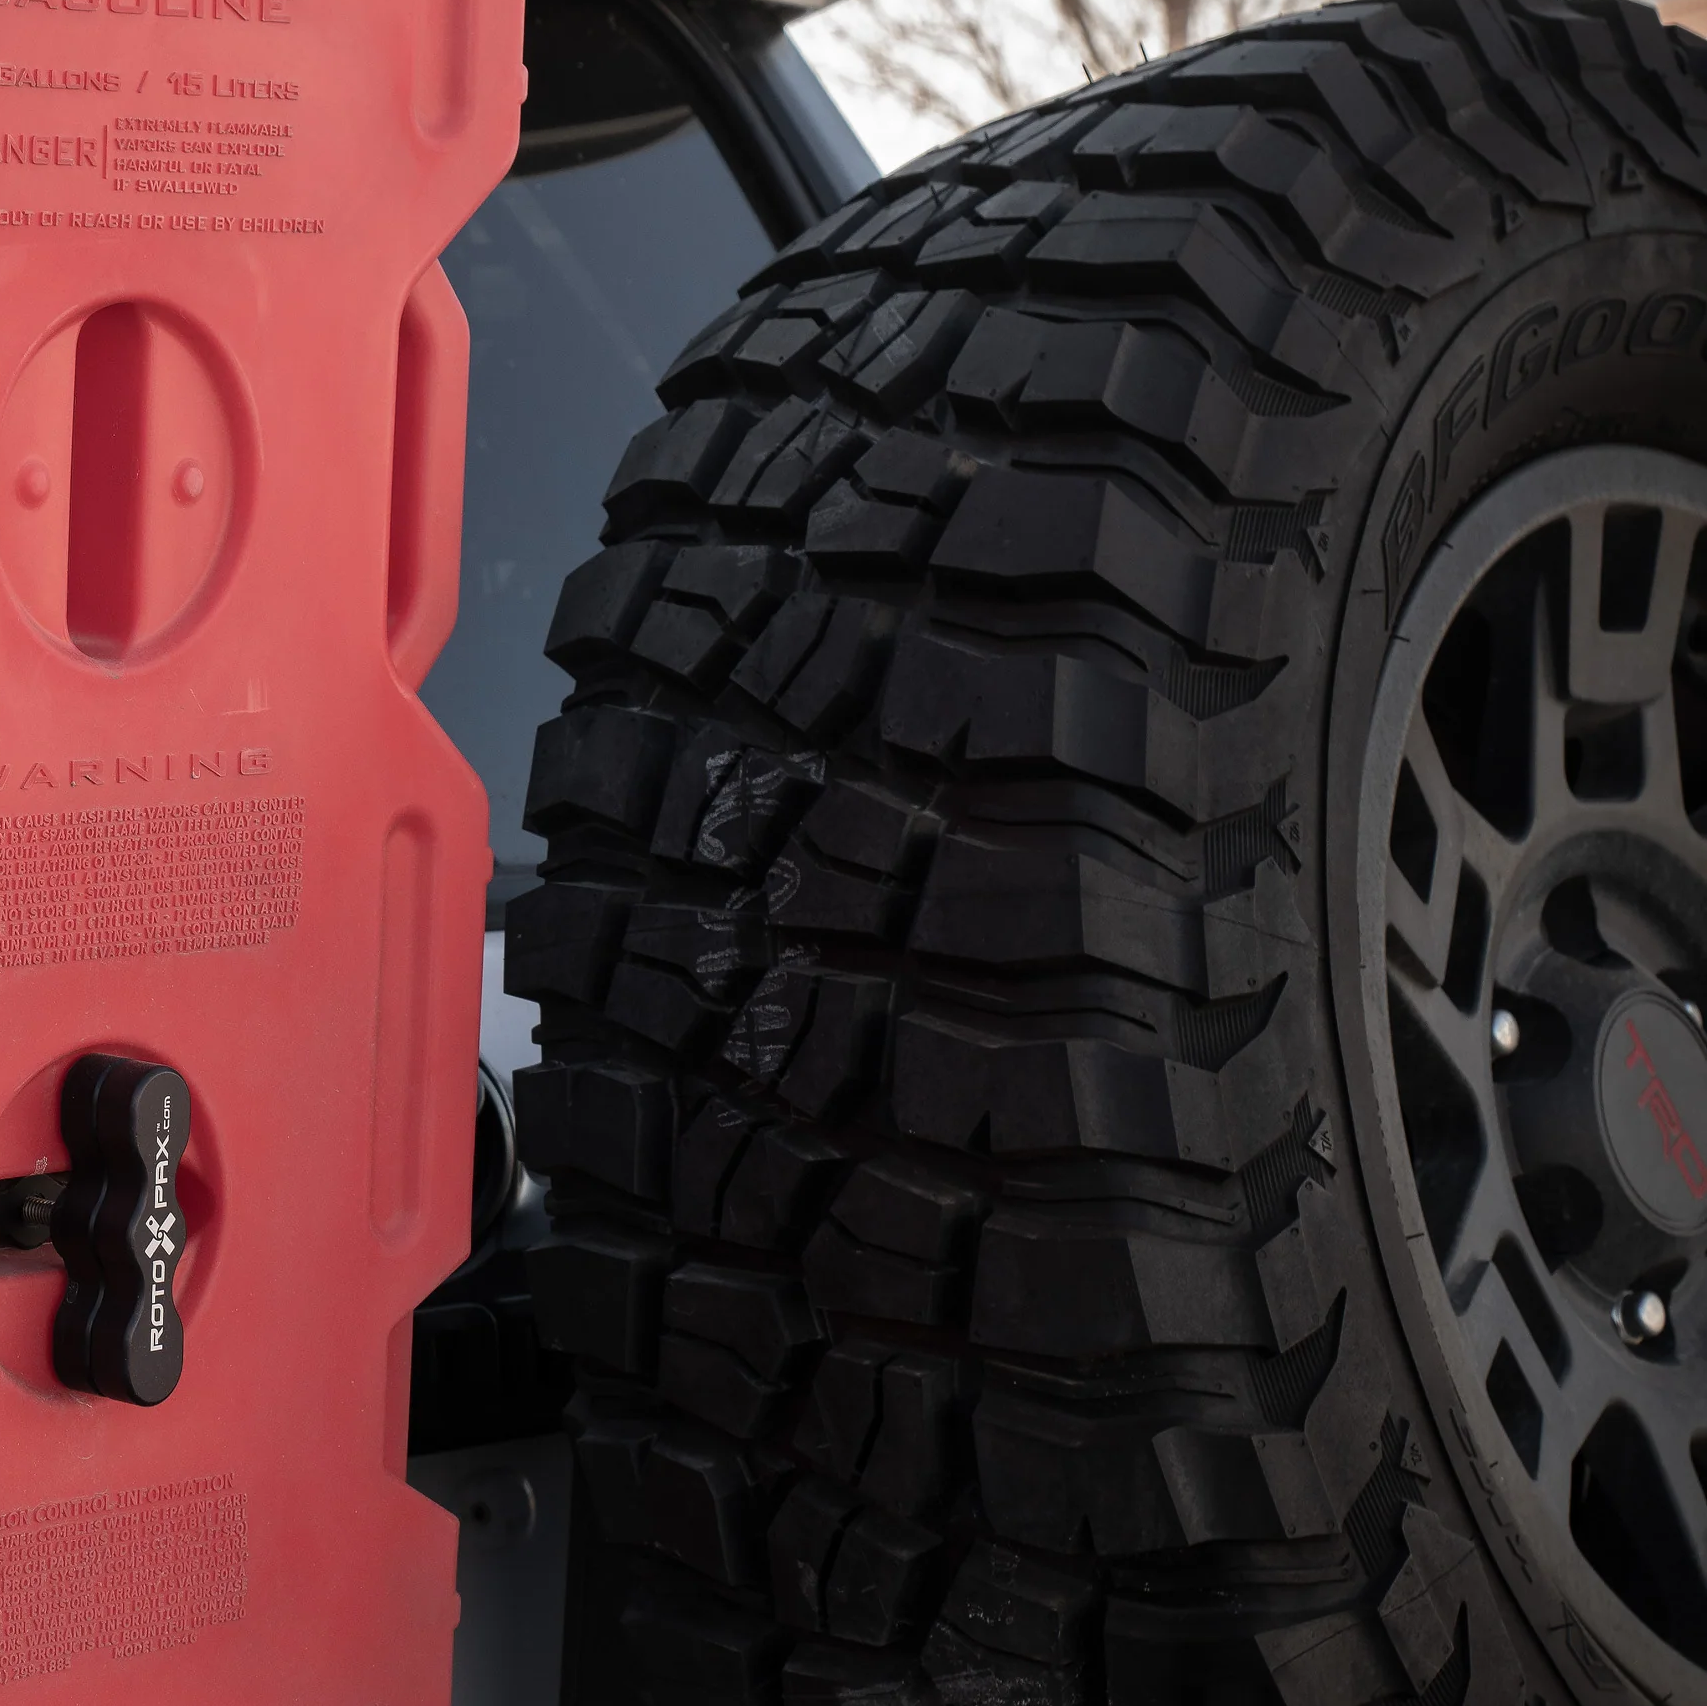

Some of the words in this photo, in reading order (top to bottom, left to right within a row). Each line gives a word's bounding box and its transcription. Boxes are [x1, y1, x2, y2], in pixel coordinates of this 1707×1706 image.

[166, 71, 204, 96] 15
[212, 74, 300, 100] LITERS
[114, 117, 203, 135] EXTREMELY
[207, 120, 294, 138] FLAMMABLE
[114, 137, 177, 154] VAPORS
[181, 140, 214, 155] CAN
[217, 141, 286, 157] EXPLODE
[114, 158, 186, 174] HARMFUL
[190, 160, 214, 175] OR
[217, 160, 262, 176] FATAL
[113, 178, 130, 191] IF
[135, 178, 239, 196] SWALLOWED
[40, 210, 64, 227] OF
[70, 211, 133, 230] REACH
[138, 214, 164, 231] OR
[171, 215, 207, 231] USE
[212, 216, 236, 232] BY
[240, 217, 326, 234] CHILDREN
[15, 812, 59, 828] CAUSE
[63, 809, 105, 825] FLASH
[147, 803, 199, 820] VAPORS
[201, 802, 229, 816] CAN
[253, 797, 305, 813] IGNITED
[7, 830, 26, 844] BY
[41, 826, 81, 842] SPARK
[85, 825, 103, 839] OR
[149, 819, 181, 835] MANY
[217, 815, 251, 830] AWAY
[263, 813, 279, 827] DO
[50, 840, 91, 857] AVOID
[157, 835, 173, 849] OR
[177, 829, 251, 848] PROLONGED
[253, 826, 305, 842] CONTACT
[16, 856, 91, 875] BREATHING
[180, 844, 258, 863] SWALLOWED
[261, 843, 279, 857] DO
[11, 920, 58, 936] REACH
[222, 899, 301, 919] CONTAINER
[27, 903, 71, 920] STORE
[33, 934, 72, 950] WHEN
[183, 917, 257, 937] CONTAINER
[261, 914, 299, 930] DAILY
[53, 948, 71, 963] IN
[175, 932, 270, 952] TEMPERATURE
[1626, 1018, 1707, 1201] TRD
[150, 1259, 167, 1351] ROTO
[35, 1493, 113, 1523] CONTROL
[119, 1471, 233, 1508] INFORMATION
